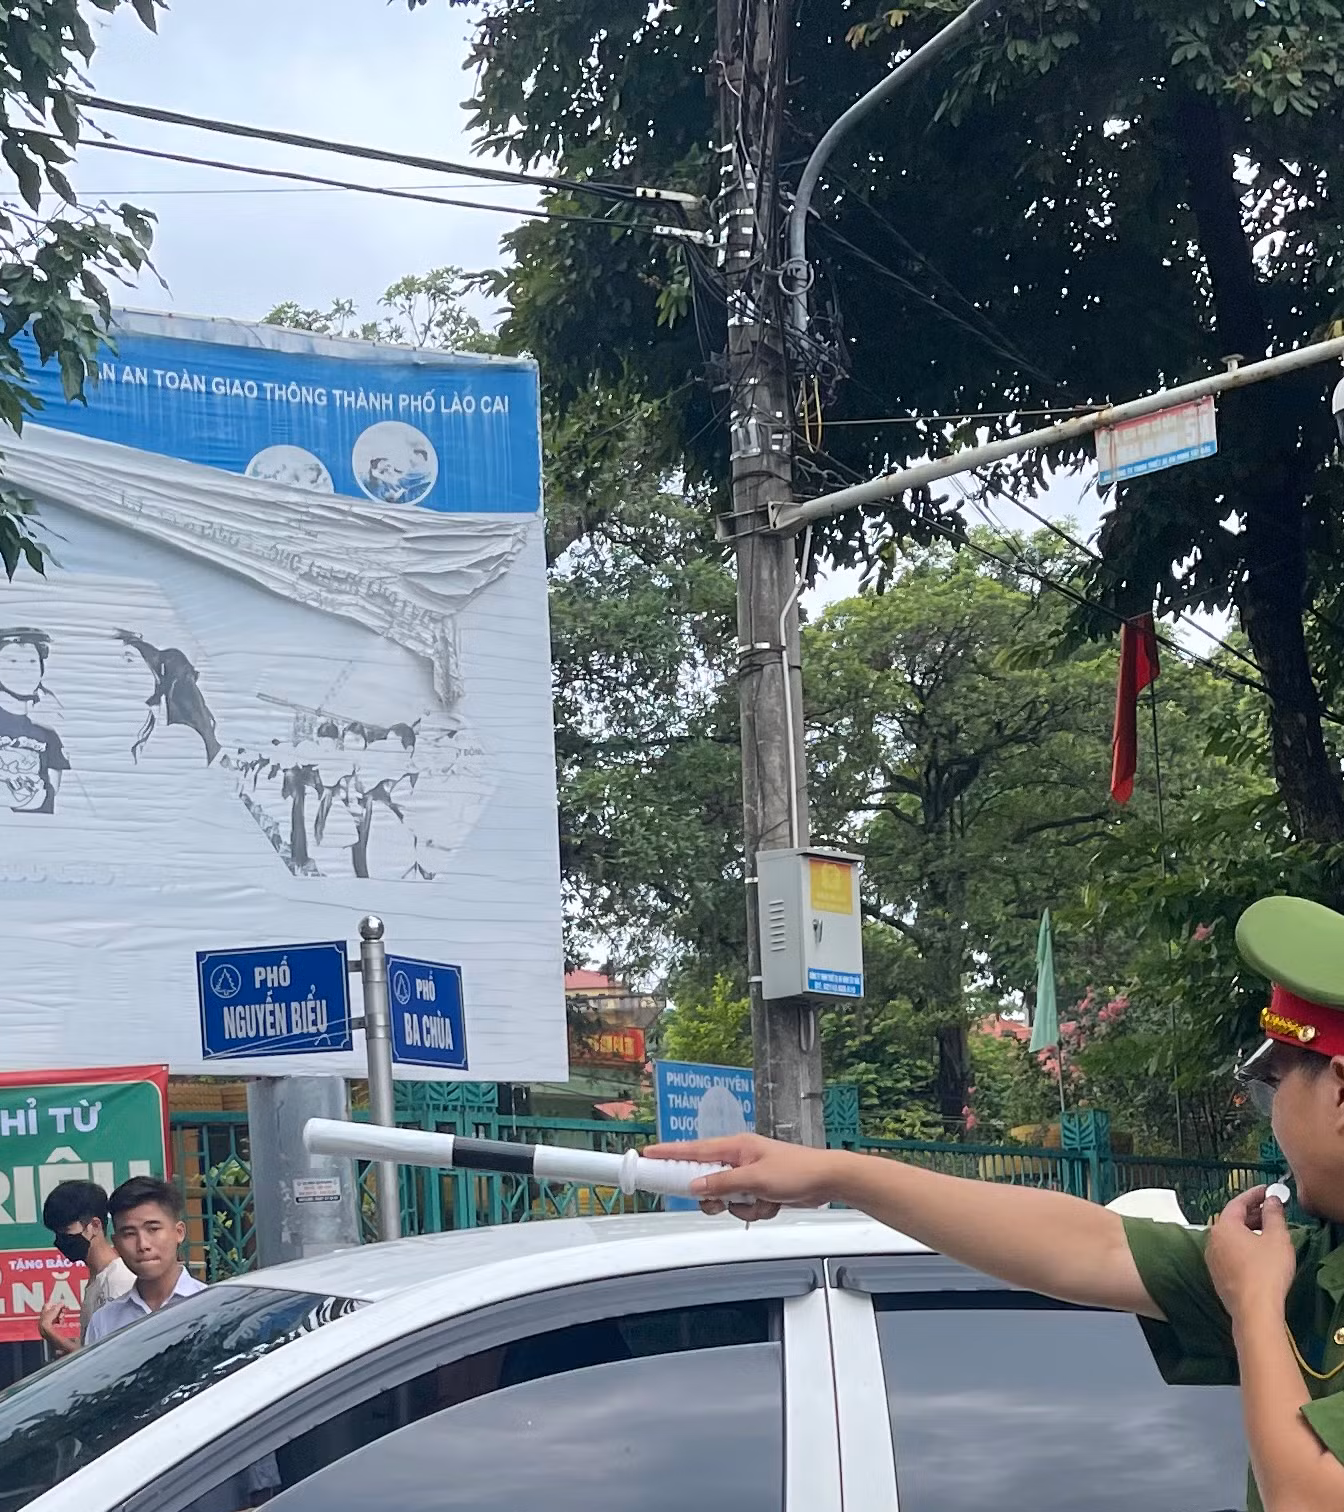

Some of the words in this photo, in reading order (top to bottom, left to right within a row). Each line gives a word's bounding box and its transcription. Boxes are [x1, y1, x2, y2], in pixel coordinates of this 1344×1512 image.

[121, 369, 147, 387] AN
[152, 370, 206, 392] TOÀN
[211, 379, 258, 398] GIAO
[263, 381, 327, 406] THÔNG
[332, 386, 393, 411] THÀNH
[399, 389, 434, 413] PHỐ
[440, 389, 475, 414] LÀO
[480, 395, 509, 414] CAI
[254, 955, 291, 989] PHỐ
[415, 970, 436, 1002] PHỐ
[291, 984, 328, 1034] BIỂU
[403, 1012, 422, 1047] BA
[422, 1009, 454, 1050] CHÙA
[48, 1099, 102, 1134] TỪ
[12, 1271, 89, 1314] NĂ
